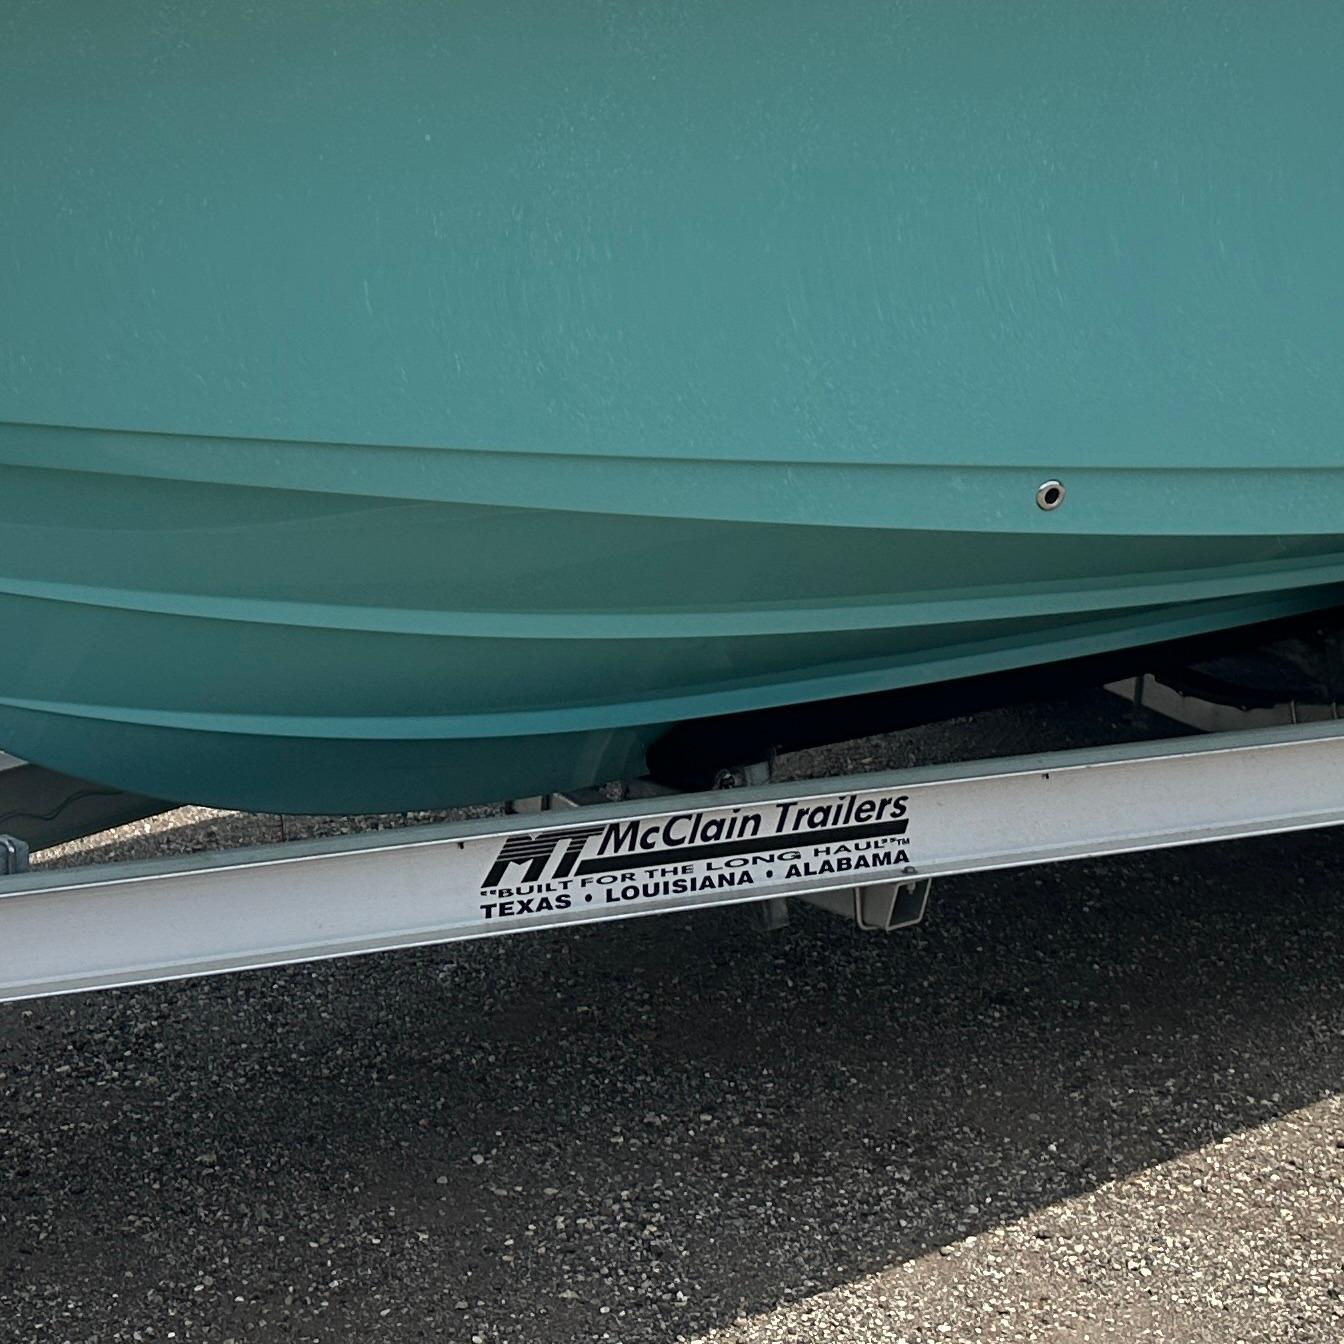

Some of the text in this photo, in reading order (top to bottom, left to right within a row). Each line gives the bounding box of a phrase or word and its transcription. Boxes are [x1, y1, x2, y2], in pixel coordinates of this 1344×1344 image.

[596, 807, 762, 856] McClain
[775, 794, 910, 834] Trailers
[480, 849, 910, 919] TEXAS LOUISIANA ALABAMA
[580, 872, 636, 888] FOR
[644, 863, 694, 880] THE
[706, 851, 802, 872] LONG
